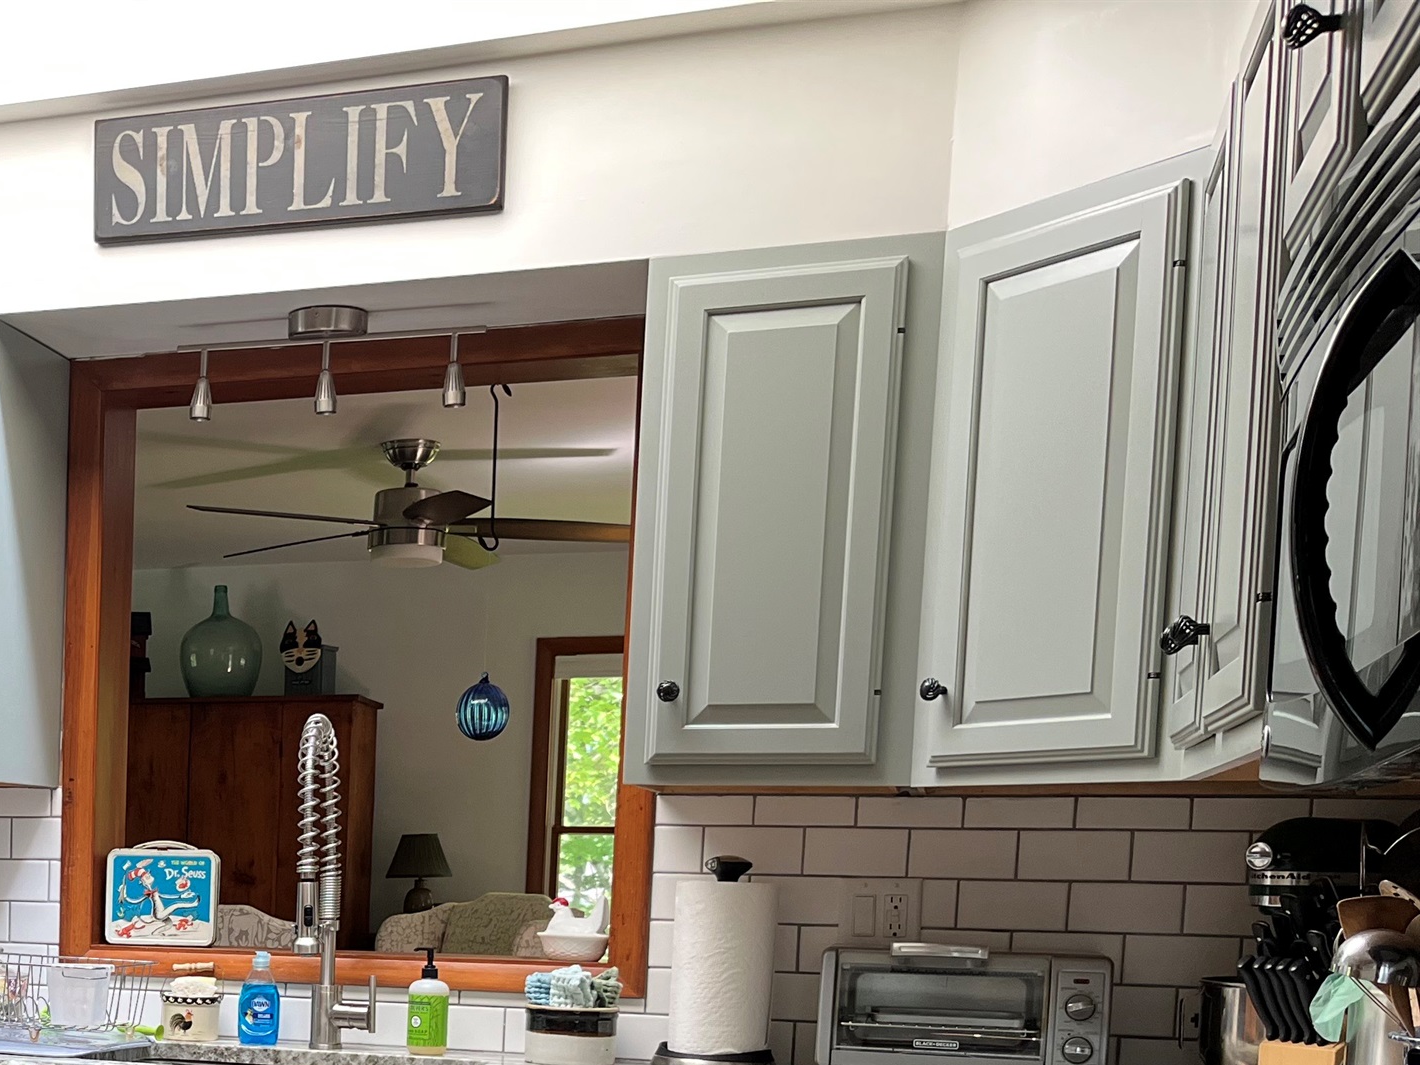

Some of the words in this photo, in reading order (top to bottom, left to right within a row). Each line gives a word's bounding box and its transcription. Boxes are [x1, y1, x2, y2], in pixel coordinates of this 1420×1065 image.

[111, 92, 484, 226] SIMPLIFY
[164, 868, 180, 880] Dr.
[182, 866, 206, 879] Seuss
[251, 1000, 270, 1008] DAWN
